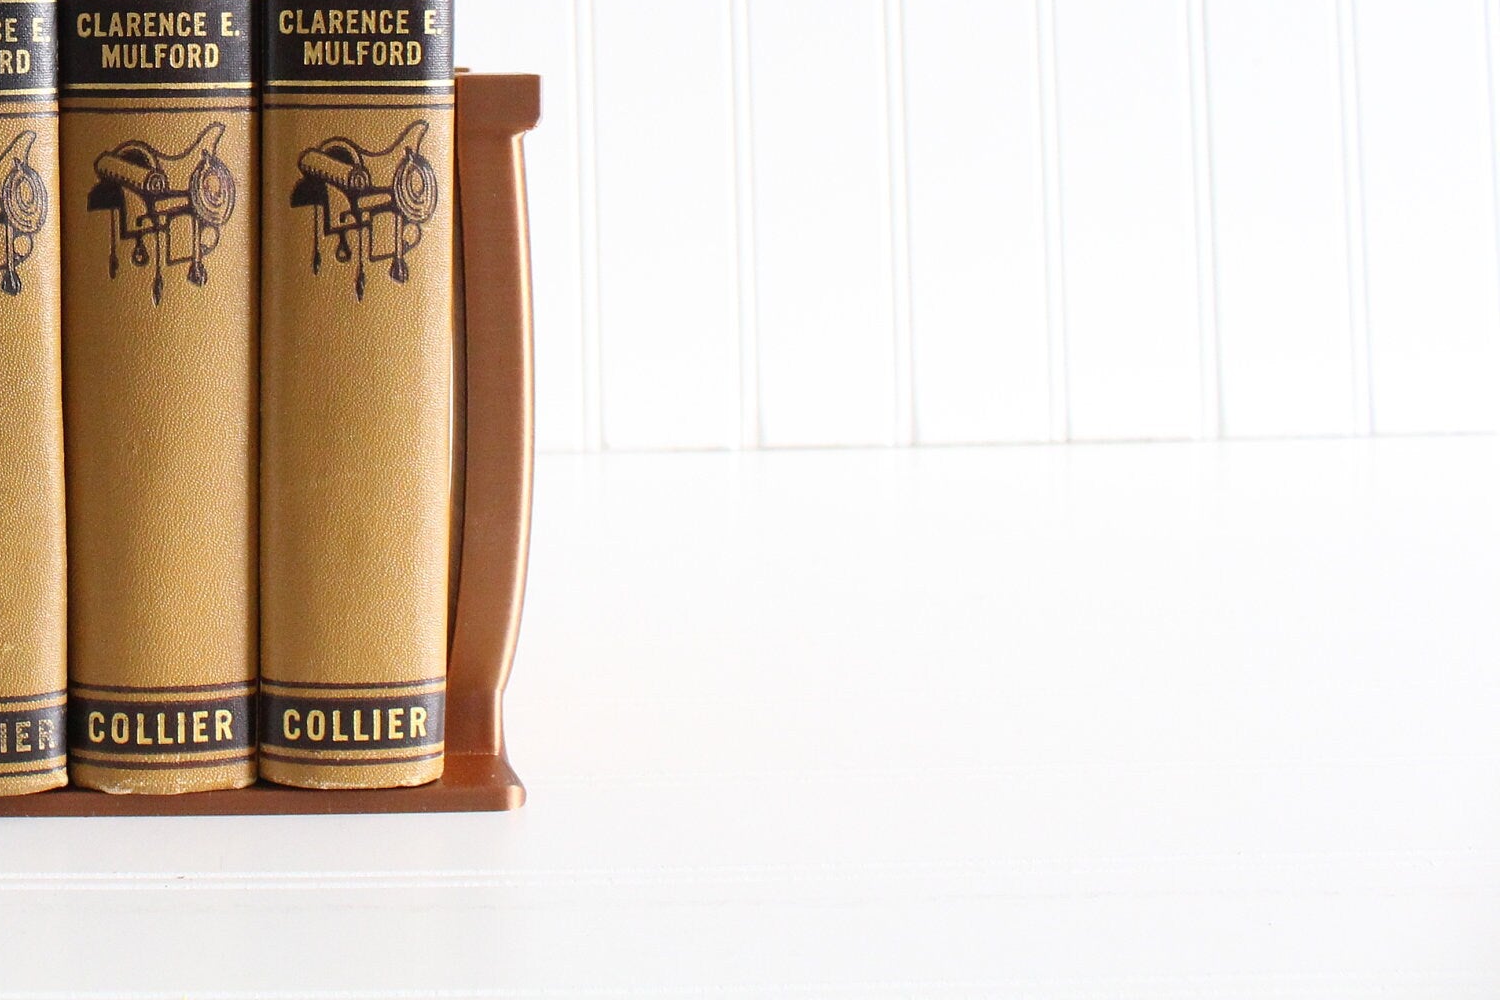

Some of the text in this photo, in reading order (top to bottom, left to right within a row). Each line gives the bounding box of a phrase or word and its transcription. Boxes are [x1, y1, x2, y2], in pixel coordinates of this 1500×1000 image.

[32, 17, 51, 43] E.
[76, 11, 240, 38] CLARENCE E.
[278, 9, 441, 35] CLARENCE E.
[100, 43, 219, 70] MULFORD
[303, 40, 422, 67] MULFORD
[87, 709, 233, 745] COLLIER
[282, 706, 427, 742] COLLIER
